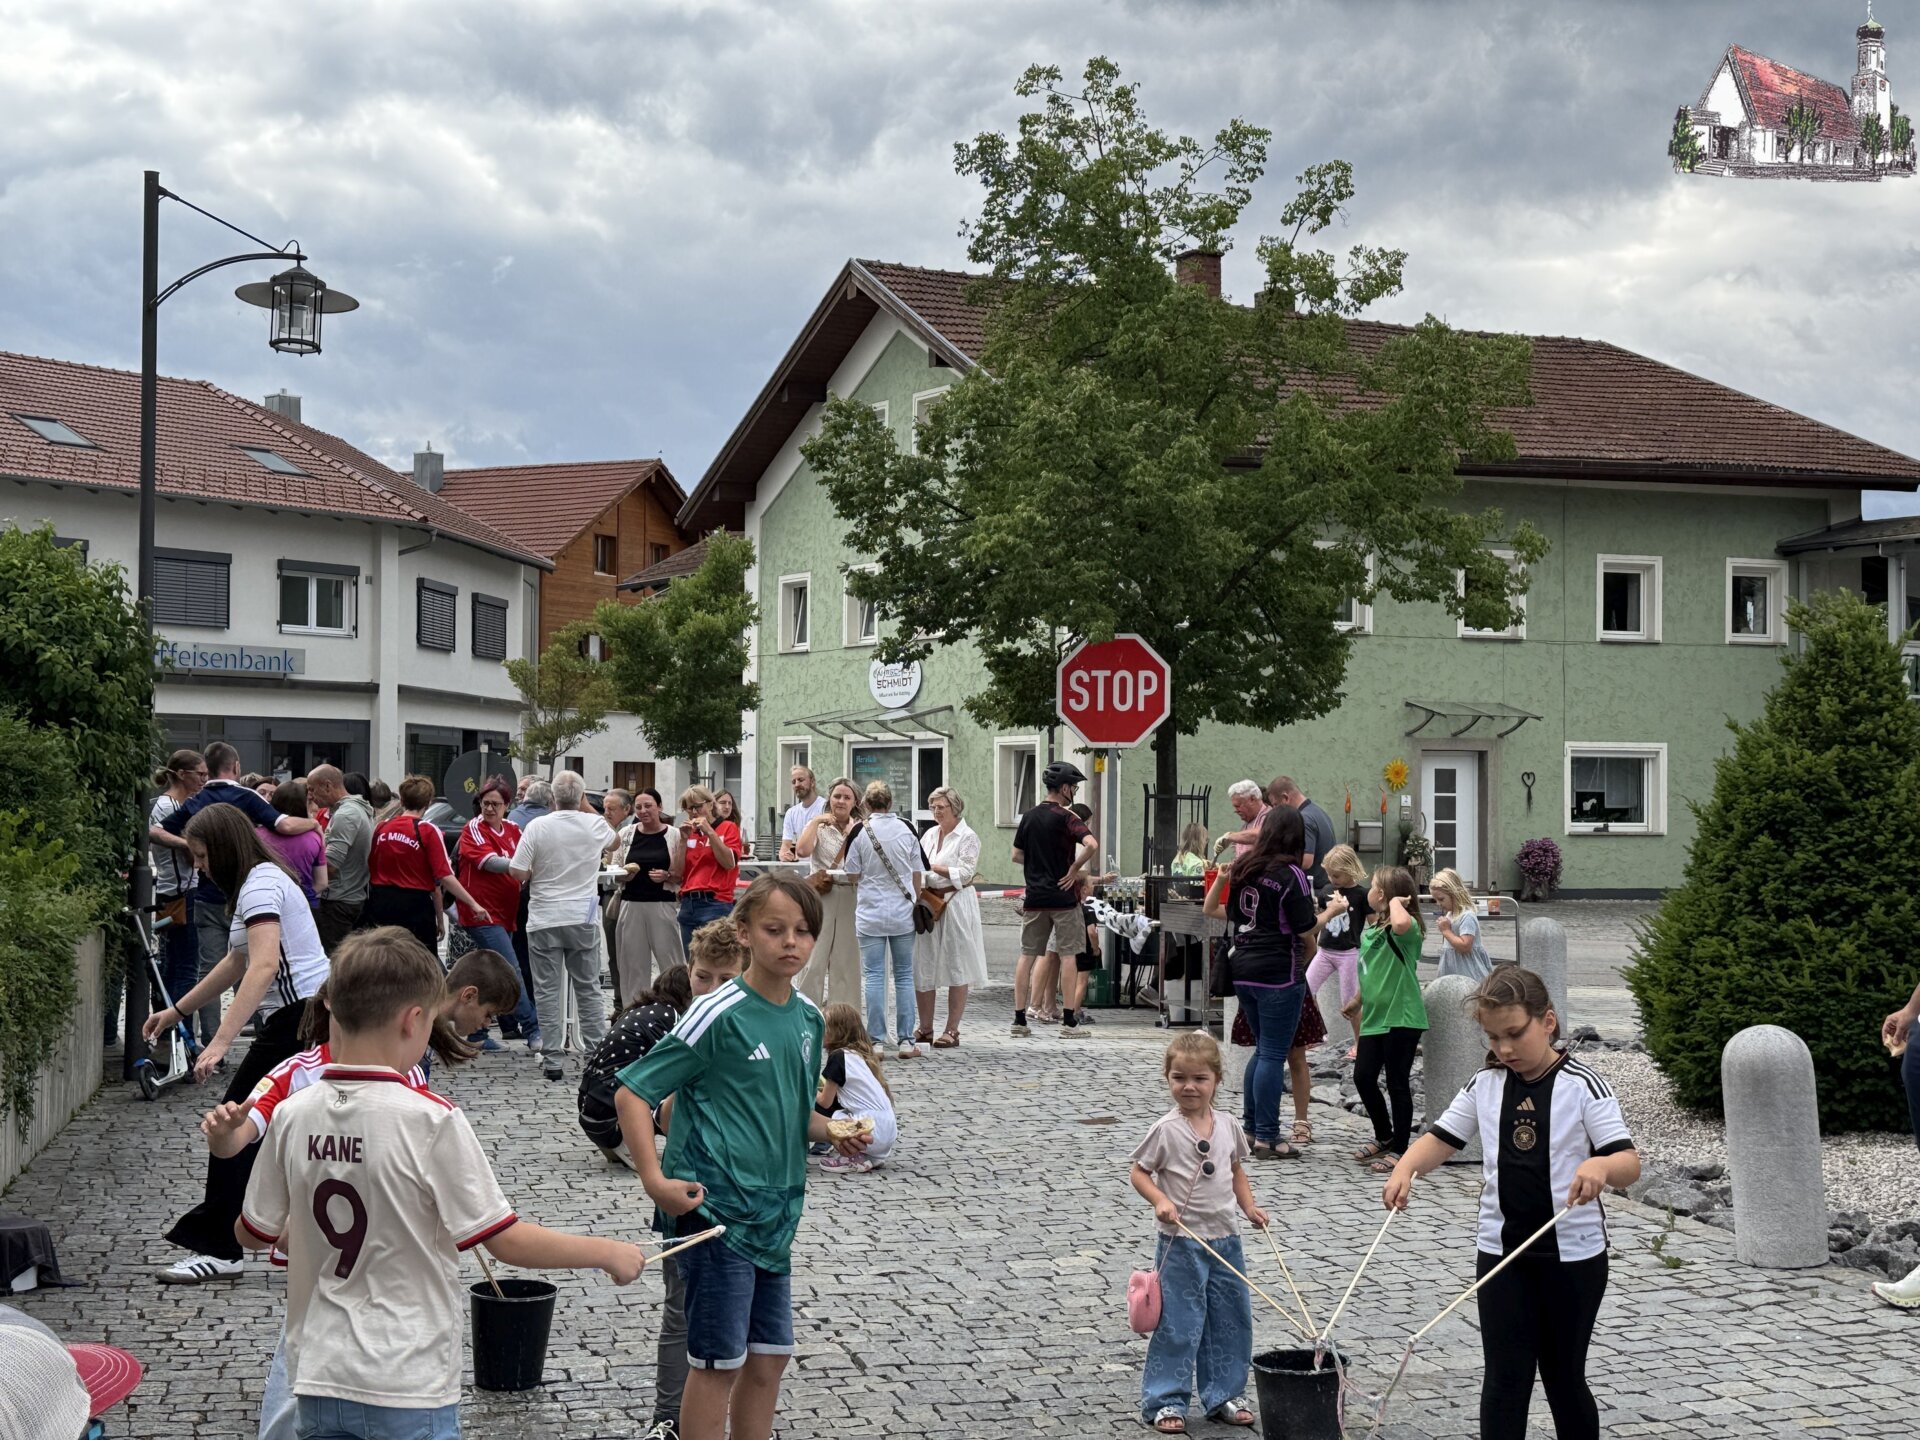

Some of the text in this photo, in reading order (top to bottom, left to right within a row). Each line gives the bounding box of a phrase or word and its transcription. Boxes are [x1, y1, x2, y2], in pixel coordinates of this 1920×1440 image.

[152, 642, 294, 672] ffeisenbank
[876, 676, 913, 689] SCHMIDT
[1069, 669, 1158, 712] STOP
[1238, 886, 1260, 933] 9
[307, 1134, 363, 1164] KANE
[312, 1178, 369, 1280] 9
